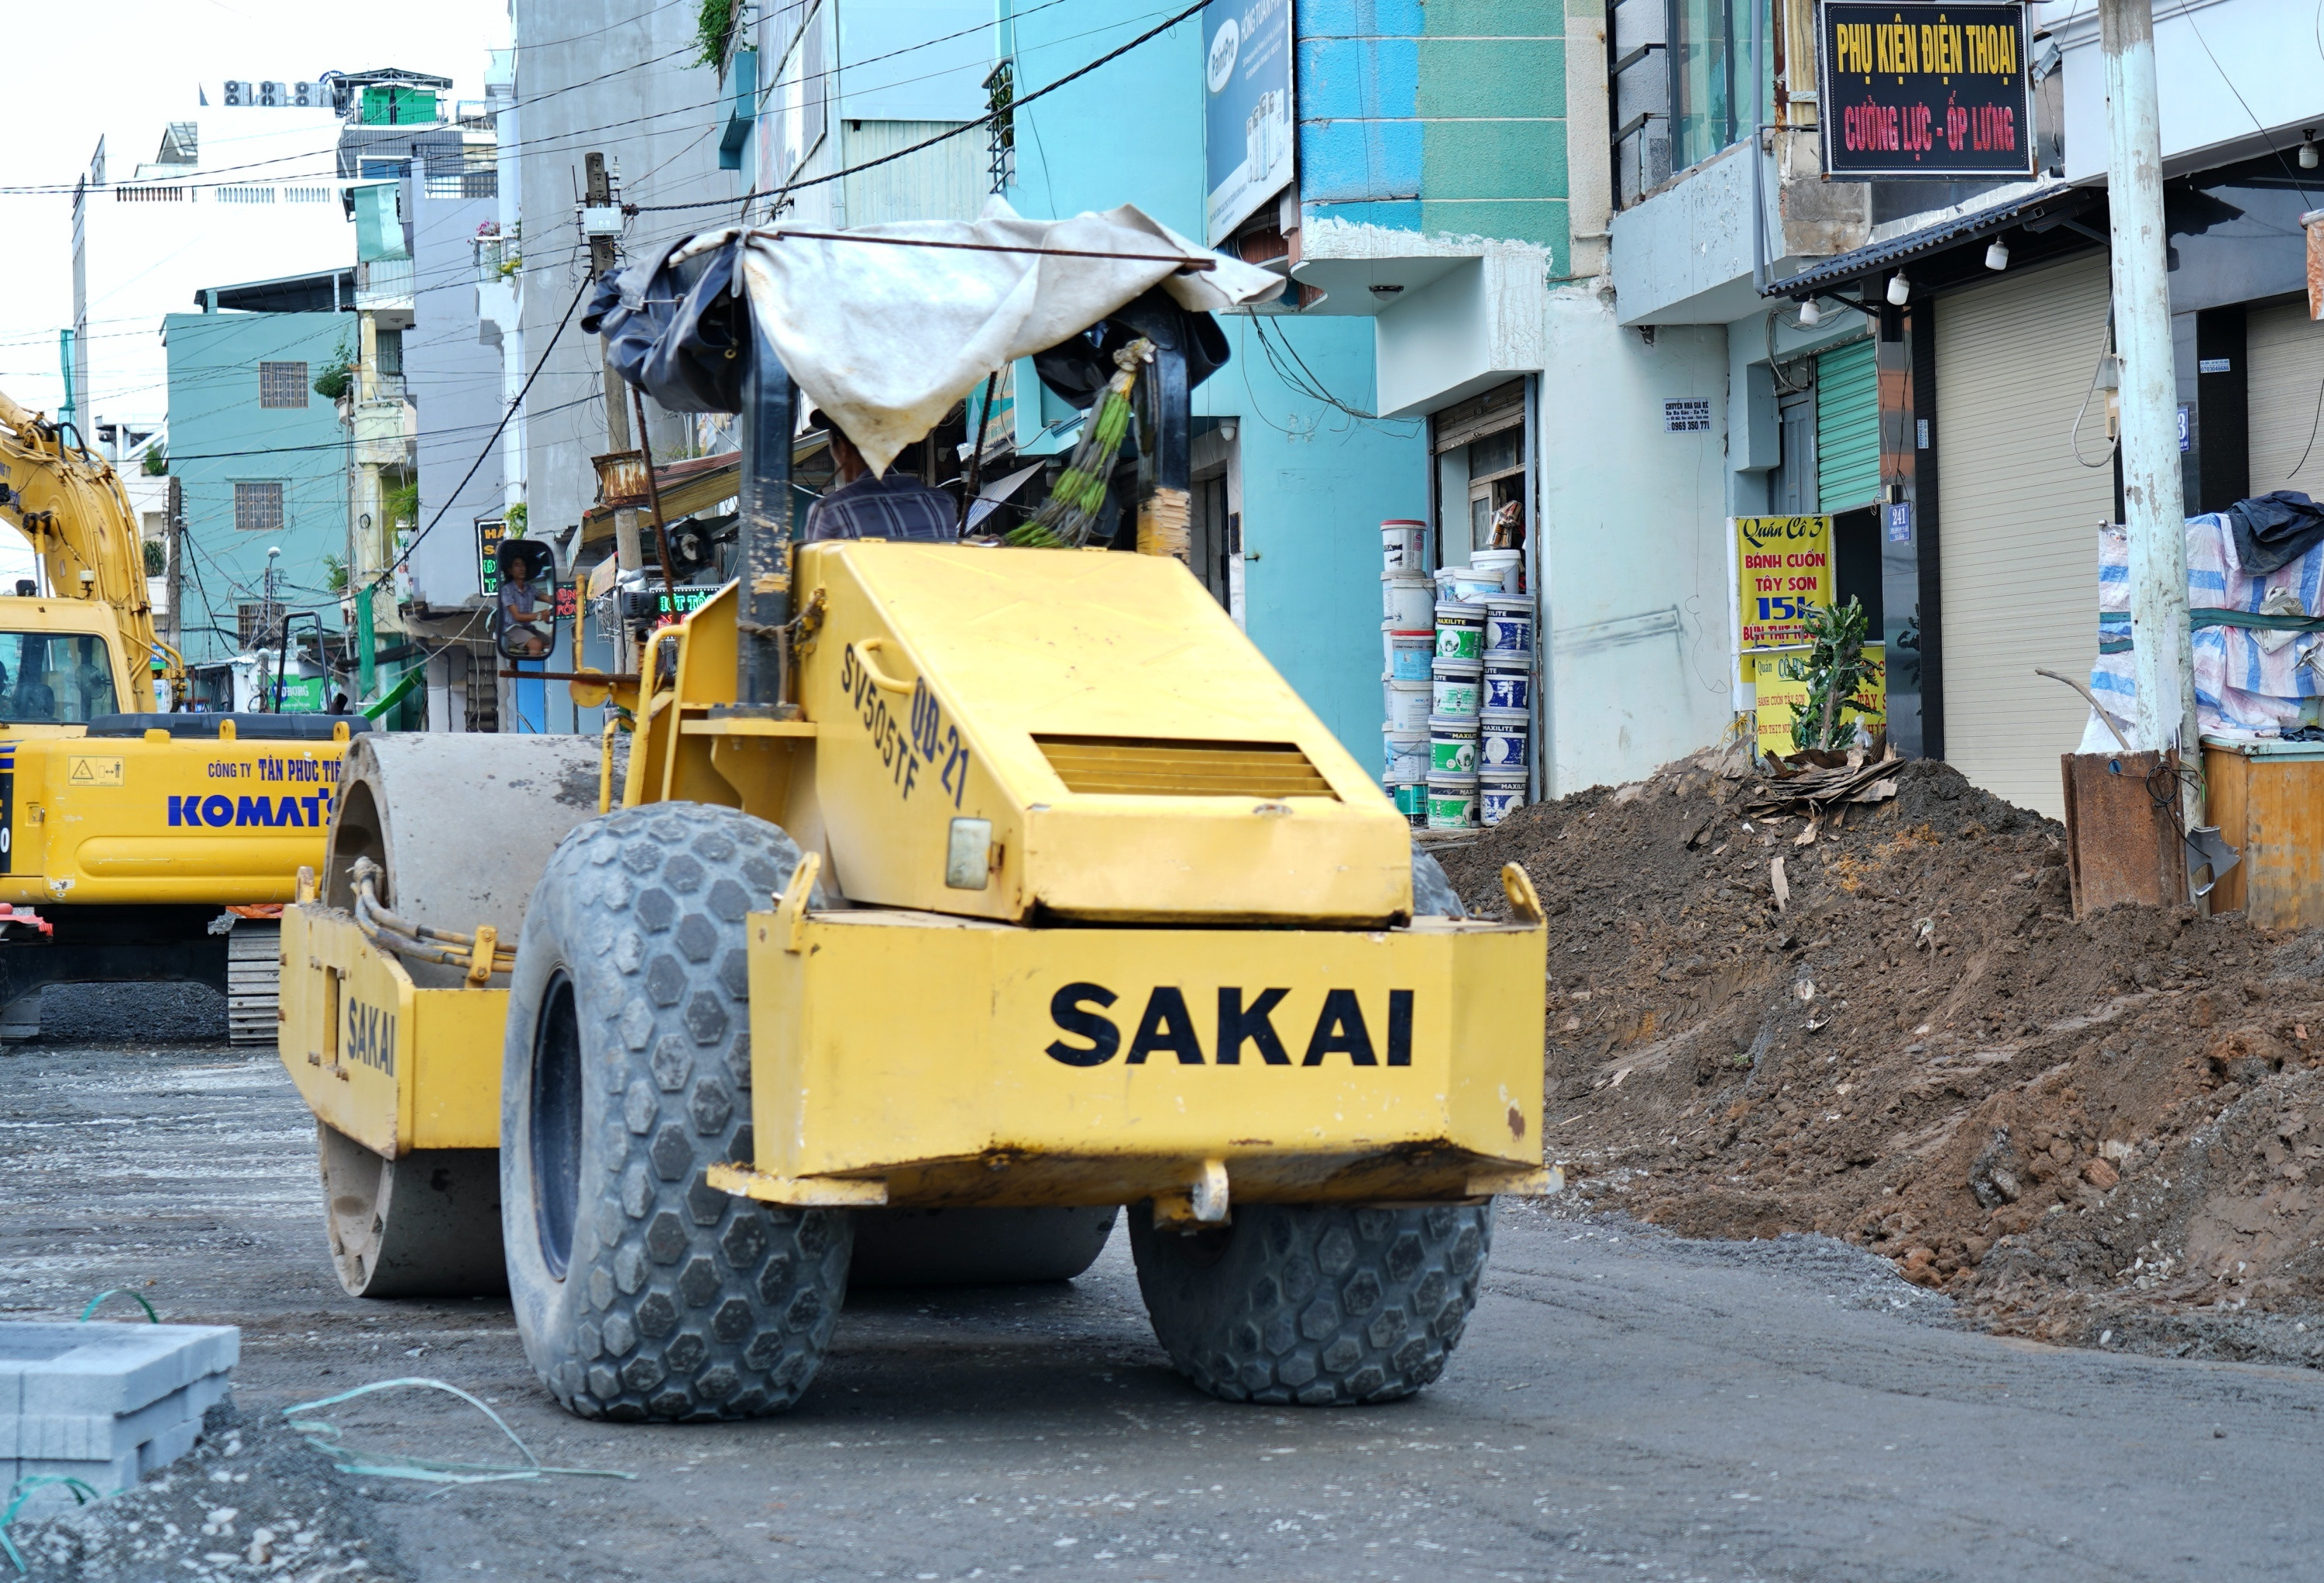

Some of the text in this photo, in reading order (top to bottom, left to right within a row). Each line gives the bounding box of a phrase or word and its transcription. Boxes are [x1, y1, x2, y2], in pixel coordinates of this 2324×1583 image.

[1212, 37, 1235, 81] PaintPro
[1837, 13, 2016, 85] PHỤ KIỆN ĐIỆN THOẠI
[1844, 95, 1899, 151] CƯỜNG
[1903, 102, 1932, 161] LỰC
[1947, 90, 1968, 151] ỐP
[1972, 102, 2014, 151] LƯNG
[1671, 421, 1686, 431] 0969
[1687, 421, 1699, 431] 350
[1743, 516, 1824, 549] Quán Cô 3
[1893, 507, 1906, 526] 241
[1745, 549, 1826, 569] BÁNH CUỐN
[1755, 575, 1817, 592] TÂY SƠN
[1758, 660, 1772, 676] Quán
[842, 642, 919, 801] SV505TF
[208, 760, 237, 778] CÔNG
[240, 762, 252, 778] TY
[258, 754, 284, 782] TÂN
[322, 752, 342, 783] TIẾ
[167, 787, 333, 828] KOMAT
[347, 996, 396, 1078] SAKAI
[1044, 981, 1415, 1067] SAKAI
